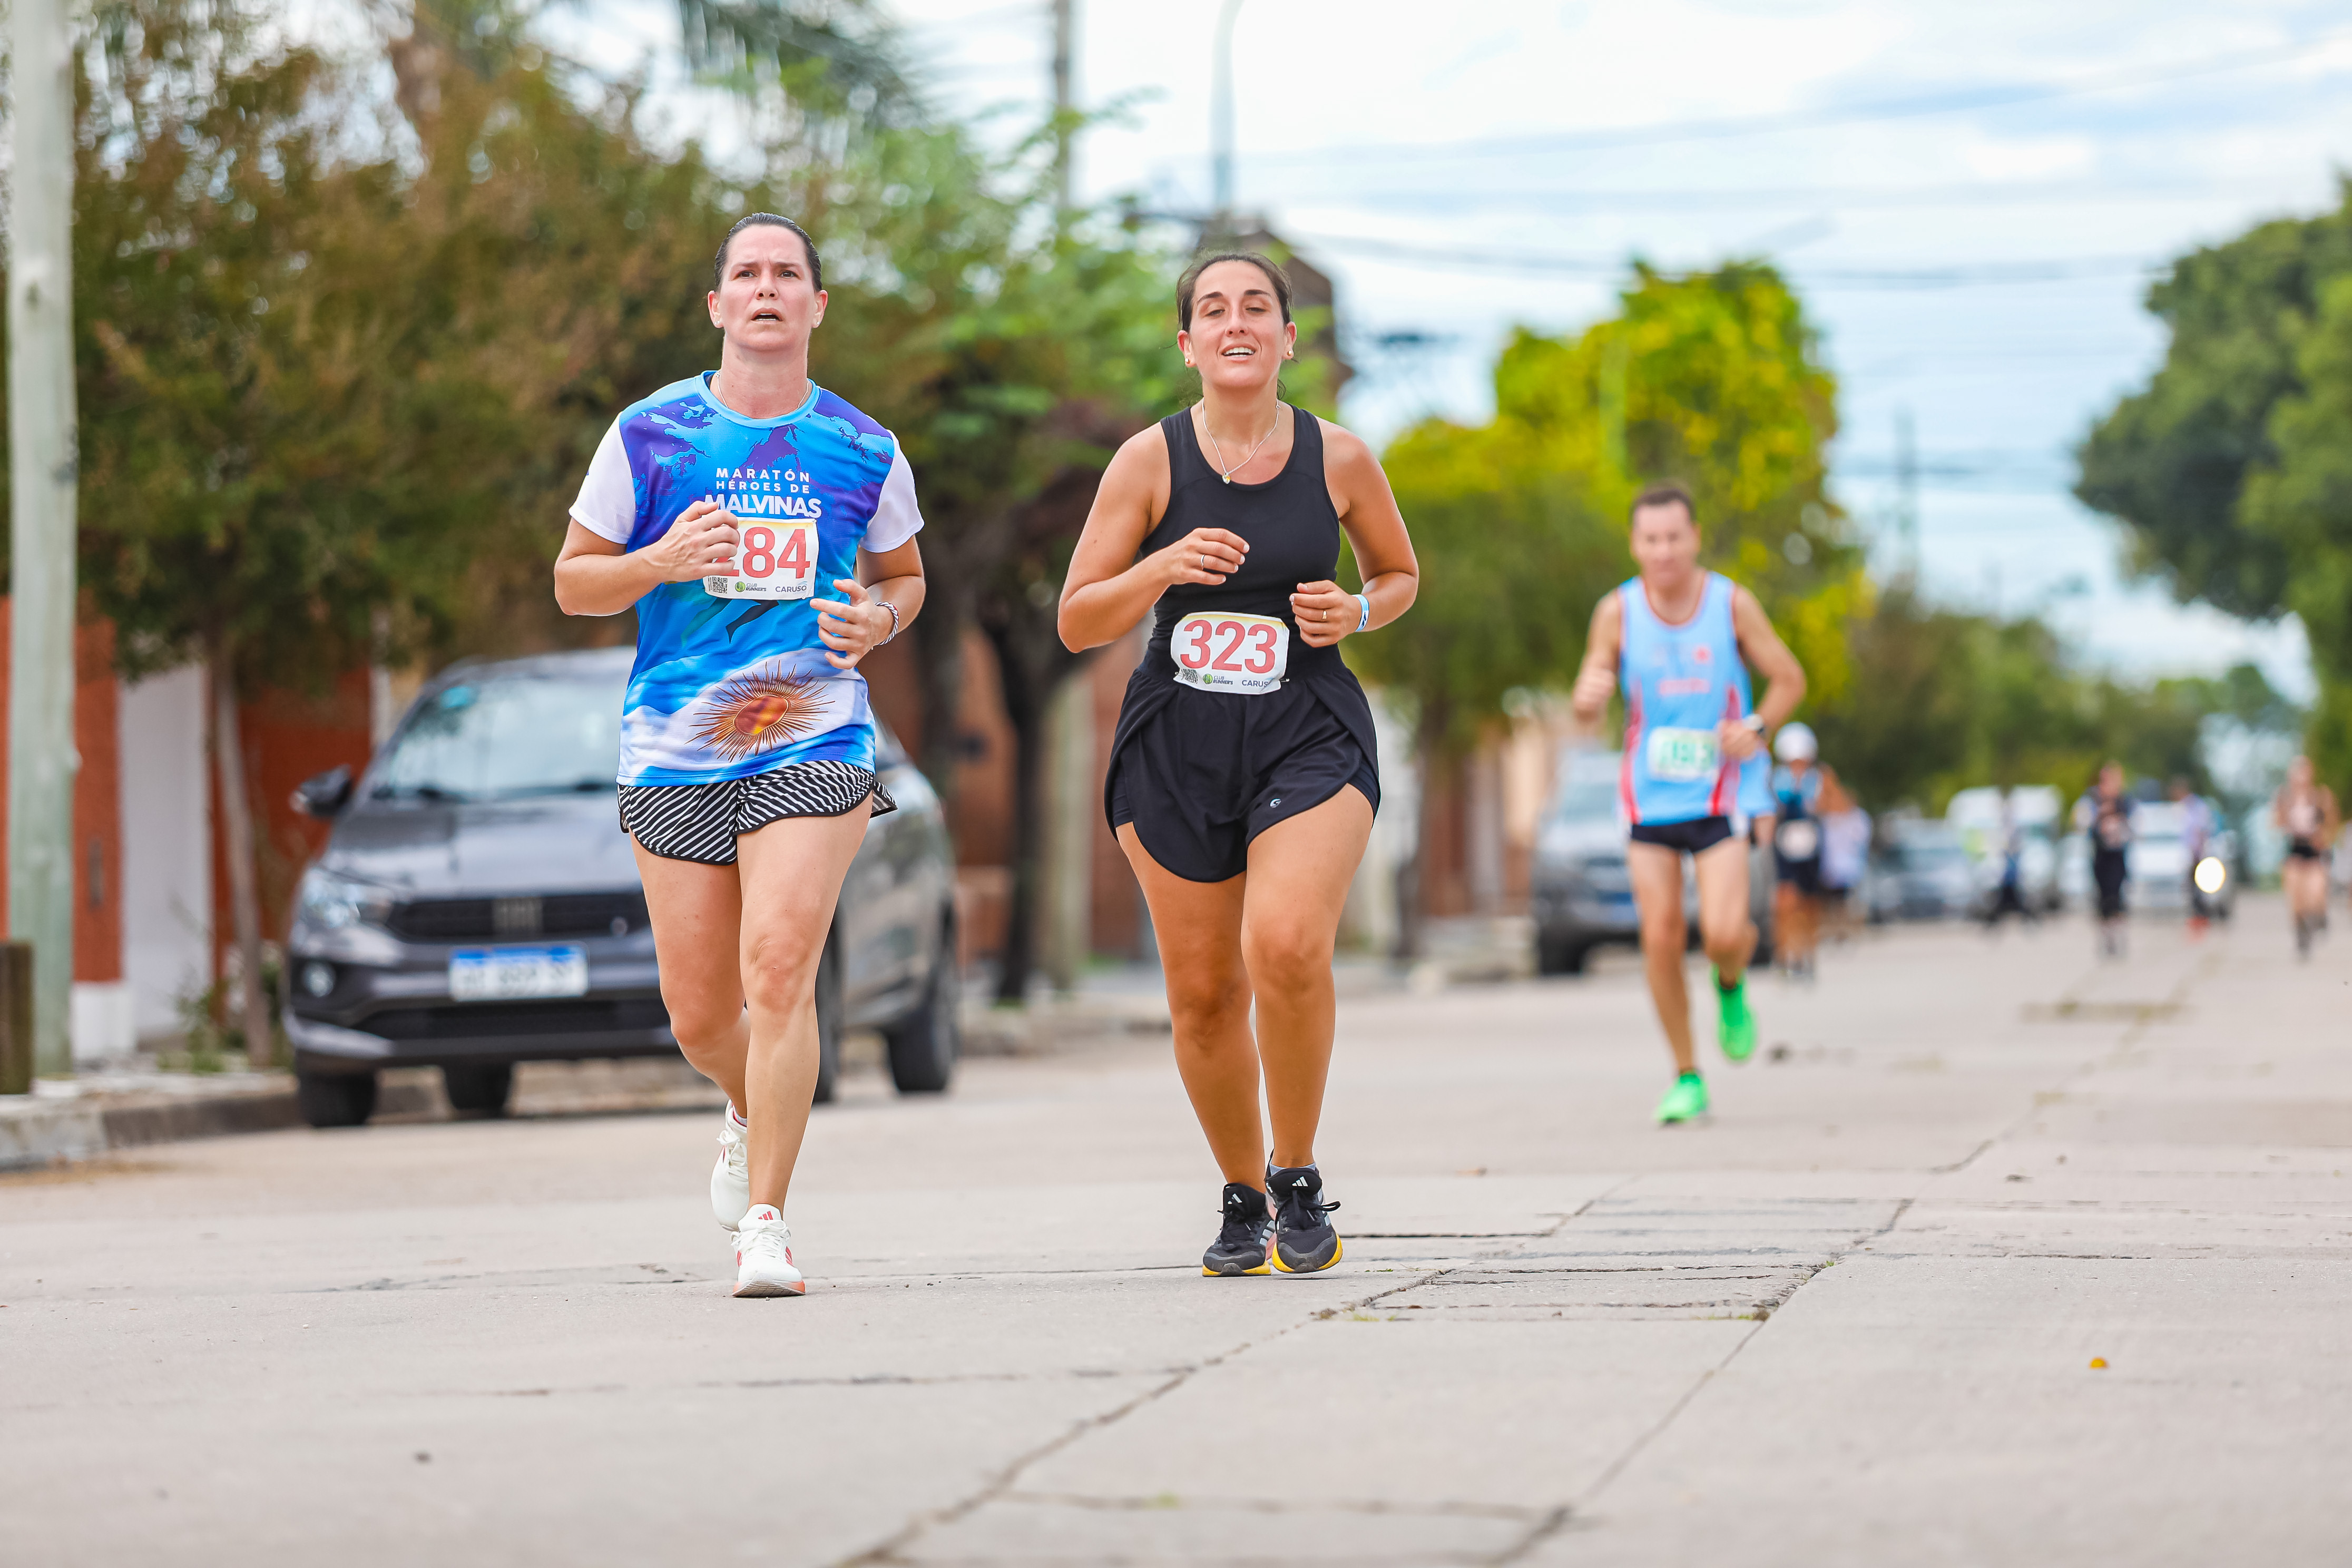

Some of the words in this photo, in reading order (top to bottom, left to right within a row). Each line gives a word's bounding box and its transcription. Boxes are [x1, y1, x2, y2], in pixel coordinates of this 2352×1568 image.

[716, 467, 810, 483] MARATÓN
[716, 479, 781, 492] HÉROES
[790, 484, 810, 494] DE
[704, 493, 822, 518] MALVINAS
[1180, 620, 1277, 674] 323
